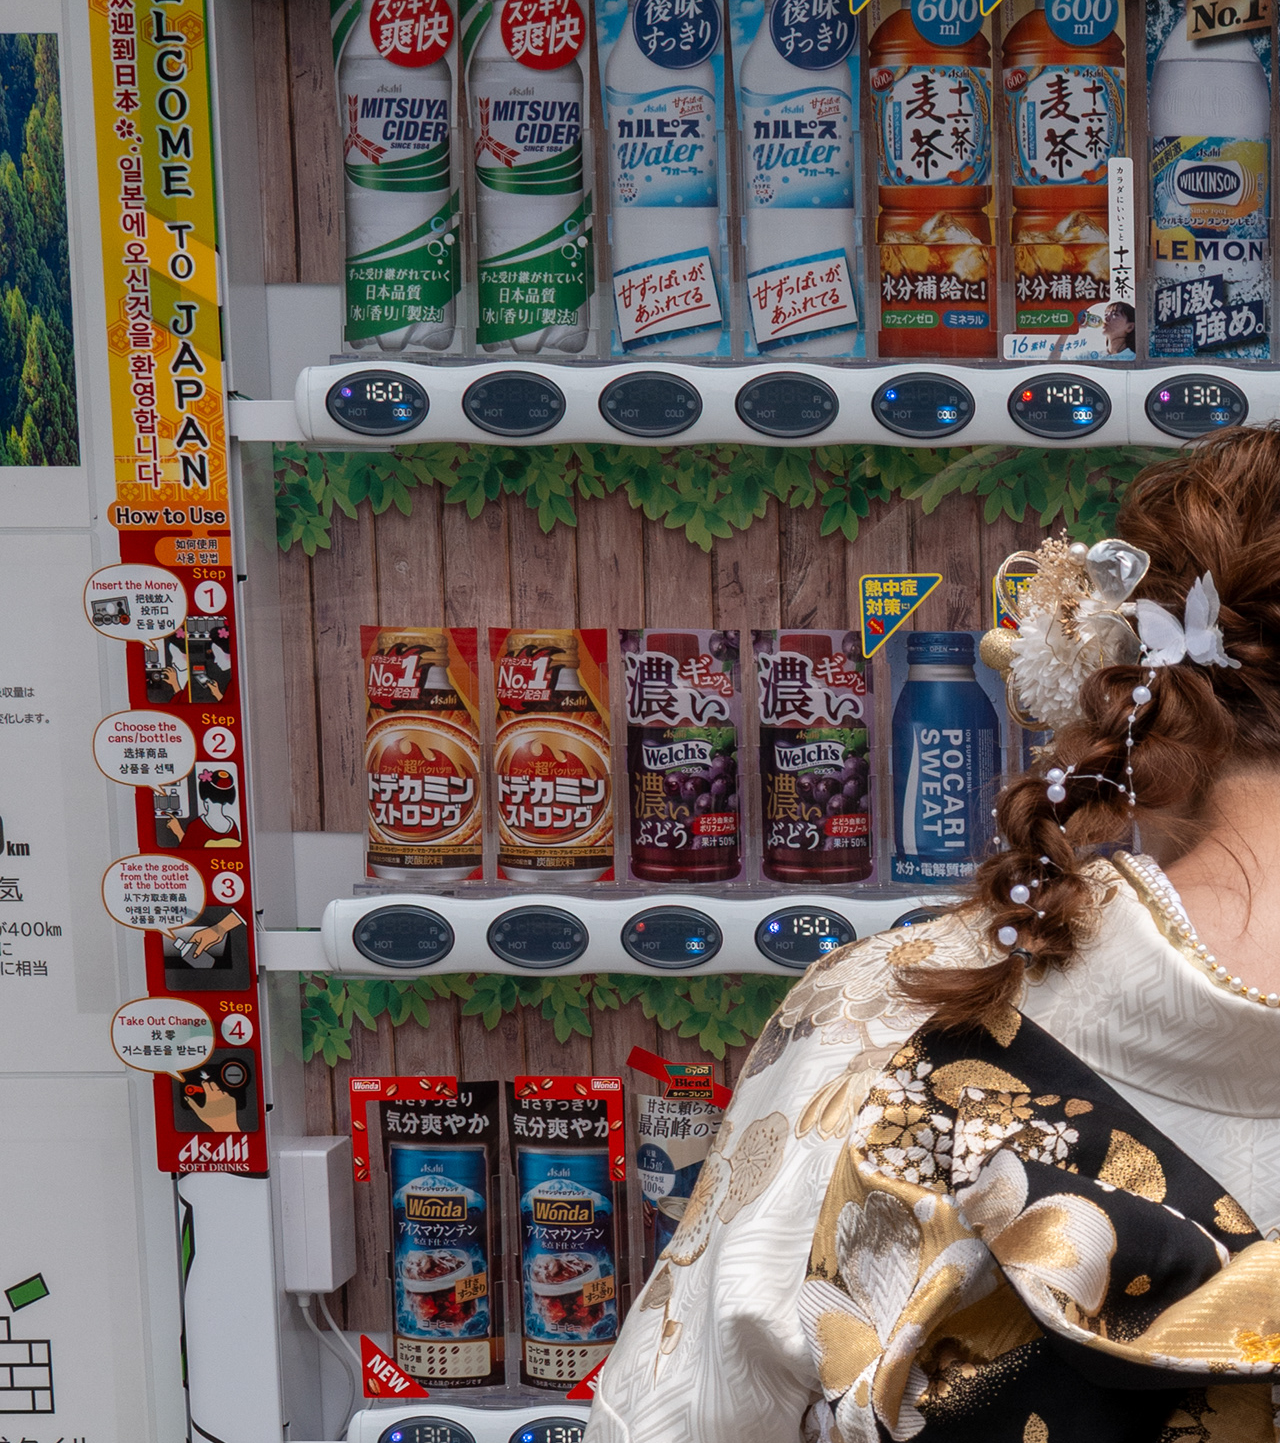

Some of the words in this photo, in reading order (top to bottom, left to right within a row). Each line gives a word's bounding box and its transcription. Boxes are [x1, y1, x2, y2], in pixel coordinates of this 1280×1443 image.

[379, 11, 449, 57] 爽快
[642, 20, 710, 53] すっきり
[938, 19, 961, 37] ml
[361, 97, 448, 120] MITSUYA
[618, 119, 701, 138] カルピス
[905, 74, 953, 180] 麦茶
[947, 82, 976, 160] 十六茶
[382, 120, 449, 142] CIDER
[617, 140, 704, 170] Water
[661, 166, 703, 176] ウォーター
[1179, 171, 1238, 193] WILKINSON
[118, 156, 147, 238] 일본에
[168, 222, 194, 281] TO
[1155, 240, 1264, 261] LEMON
[123, 242, 154, 346] 오신것을
[366, 284, 422, 300] 日本品質
[882, 272, 987, 303] 水分補給に!
[948, 313, 984, 326] ミネラル
[1196, 305, 1265, 347] 強め。
[1011, 337, 1029, 355] 16
[168, 301, 210, 490] JAPAN
[365, 382, 403, 400] 160
[1046, 385, 1083, 405] 140
[1181, 387, 1221, 406] 130
[392, 407, 414, 417] COLD
[129, 353, 164, 490] 환영합니다
[115, 505, 160, 525] How
[162, 506, 185, 525] to
[189, 506, 226, 527] Use
[175, 538, 218, 551] 如何使用
[176, 552, 196, 564] 사용
[199, 552, 219, 564] 방법
[193, 568, 226, 580] Step
[91, 579, 123, 590] Insert
[124, 579, 142, 590] the
[144, 579, 179, 592] Money
[135, 593, 174, 604] 把钱放入
[203, 587, 215, 608] 1
[140, 606, 170, 616] 投币口
[136, 618, 156, 630] 돈을
[929, 645, 948, 653] OPEN
[0, 687, 35, 698] 収量は
[367, 687, 421, 699] アルギニン配合量
[629, 657, 727, 722] 濃い
[114, 721, 157, 732] Choose
[108, 732, 183, 744] cans/bottles
[211, 733, 227, 754] 2
[123, 748, 169, 759] 选择商品
[644, 742, 709, 769] Welch's
[119, 763, 151, 775] 상품을
[153, 763, 175, 775] 선택
[368, 774, 474, 804] ドデカミン
[919, 729, 943, 837] SWEAT
[942, 729, 966, 848] POCARI
[375, 803, 462, 827] ストロング
[700, 817, 735, 825] ぶどう由来の
[635, 821, 688, 850] ぶどう
[701, 837, 717, 848] 果汁
[719, 837, 735, 847] 50%
[120, 862, 142, 872] Take
[161, 862, 190, 873] goods
[404, 855, 444, 867] 炭酸飲料
[120, 872, 143, 881] from
[160, 872, 190, 881] outlet
[123, 881, 133, 890] at
[153, 881, 188, 890] bottom
[220, 878, 236, 899] 3
[123, 893, 188, 903] 从下方取走商品
[125, 905, 151, 915] 아래의
[792, 918, 830, 936] 150
[147, 1016, 166, 1026] Out
[167, 1016, 207, 1028] Change
[228, 1020, 245, 1041] 4
[122, 1045, 173, 1056] 거스름돈을
[176, 1045, 207, 1056] 받는다
[685, 1066, 709, 1075] DyDo
[354, 1081, 380, 1090] Wonda
[674, 1078, 710, 1088] Blend
[386, 1110, 490, 1135] 気分爽やか
[178, 1134, 249, 1162] Asahi
[179, 1162, 205, 1173] SOFT
[206, 1162, 250, 1172] DRINKS
[643, 1181, 665, 1195] 100%
[399, 1221, 477, 1237] アイスマウンテン
[422, 1319, 453, 1329] コーヒー
[400, 1343, 422, 1353] コーヒー感
[400, 1353, 422, 1364] ミルク感
[365, 1354, 411, 1394] NEW
